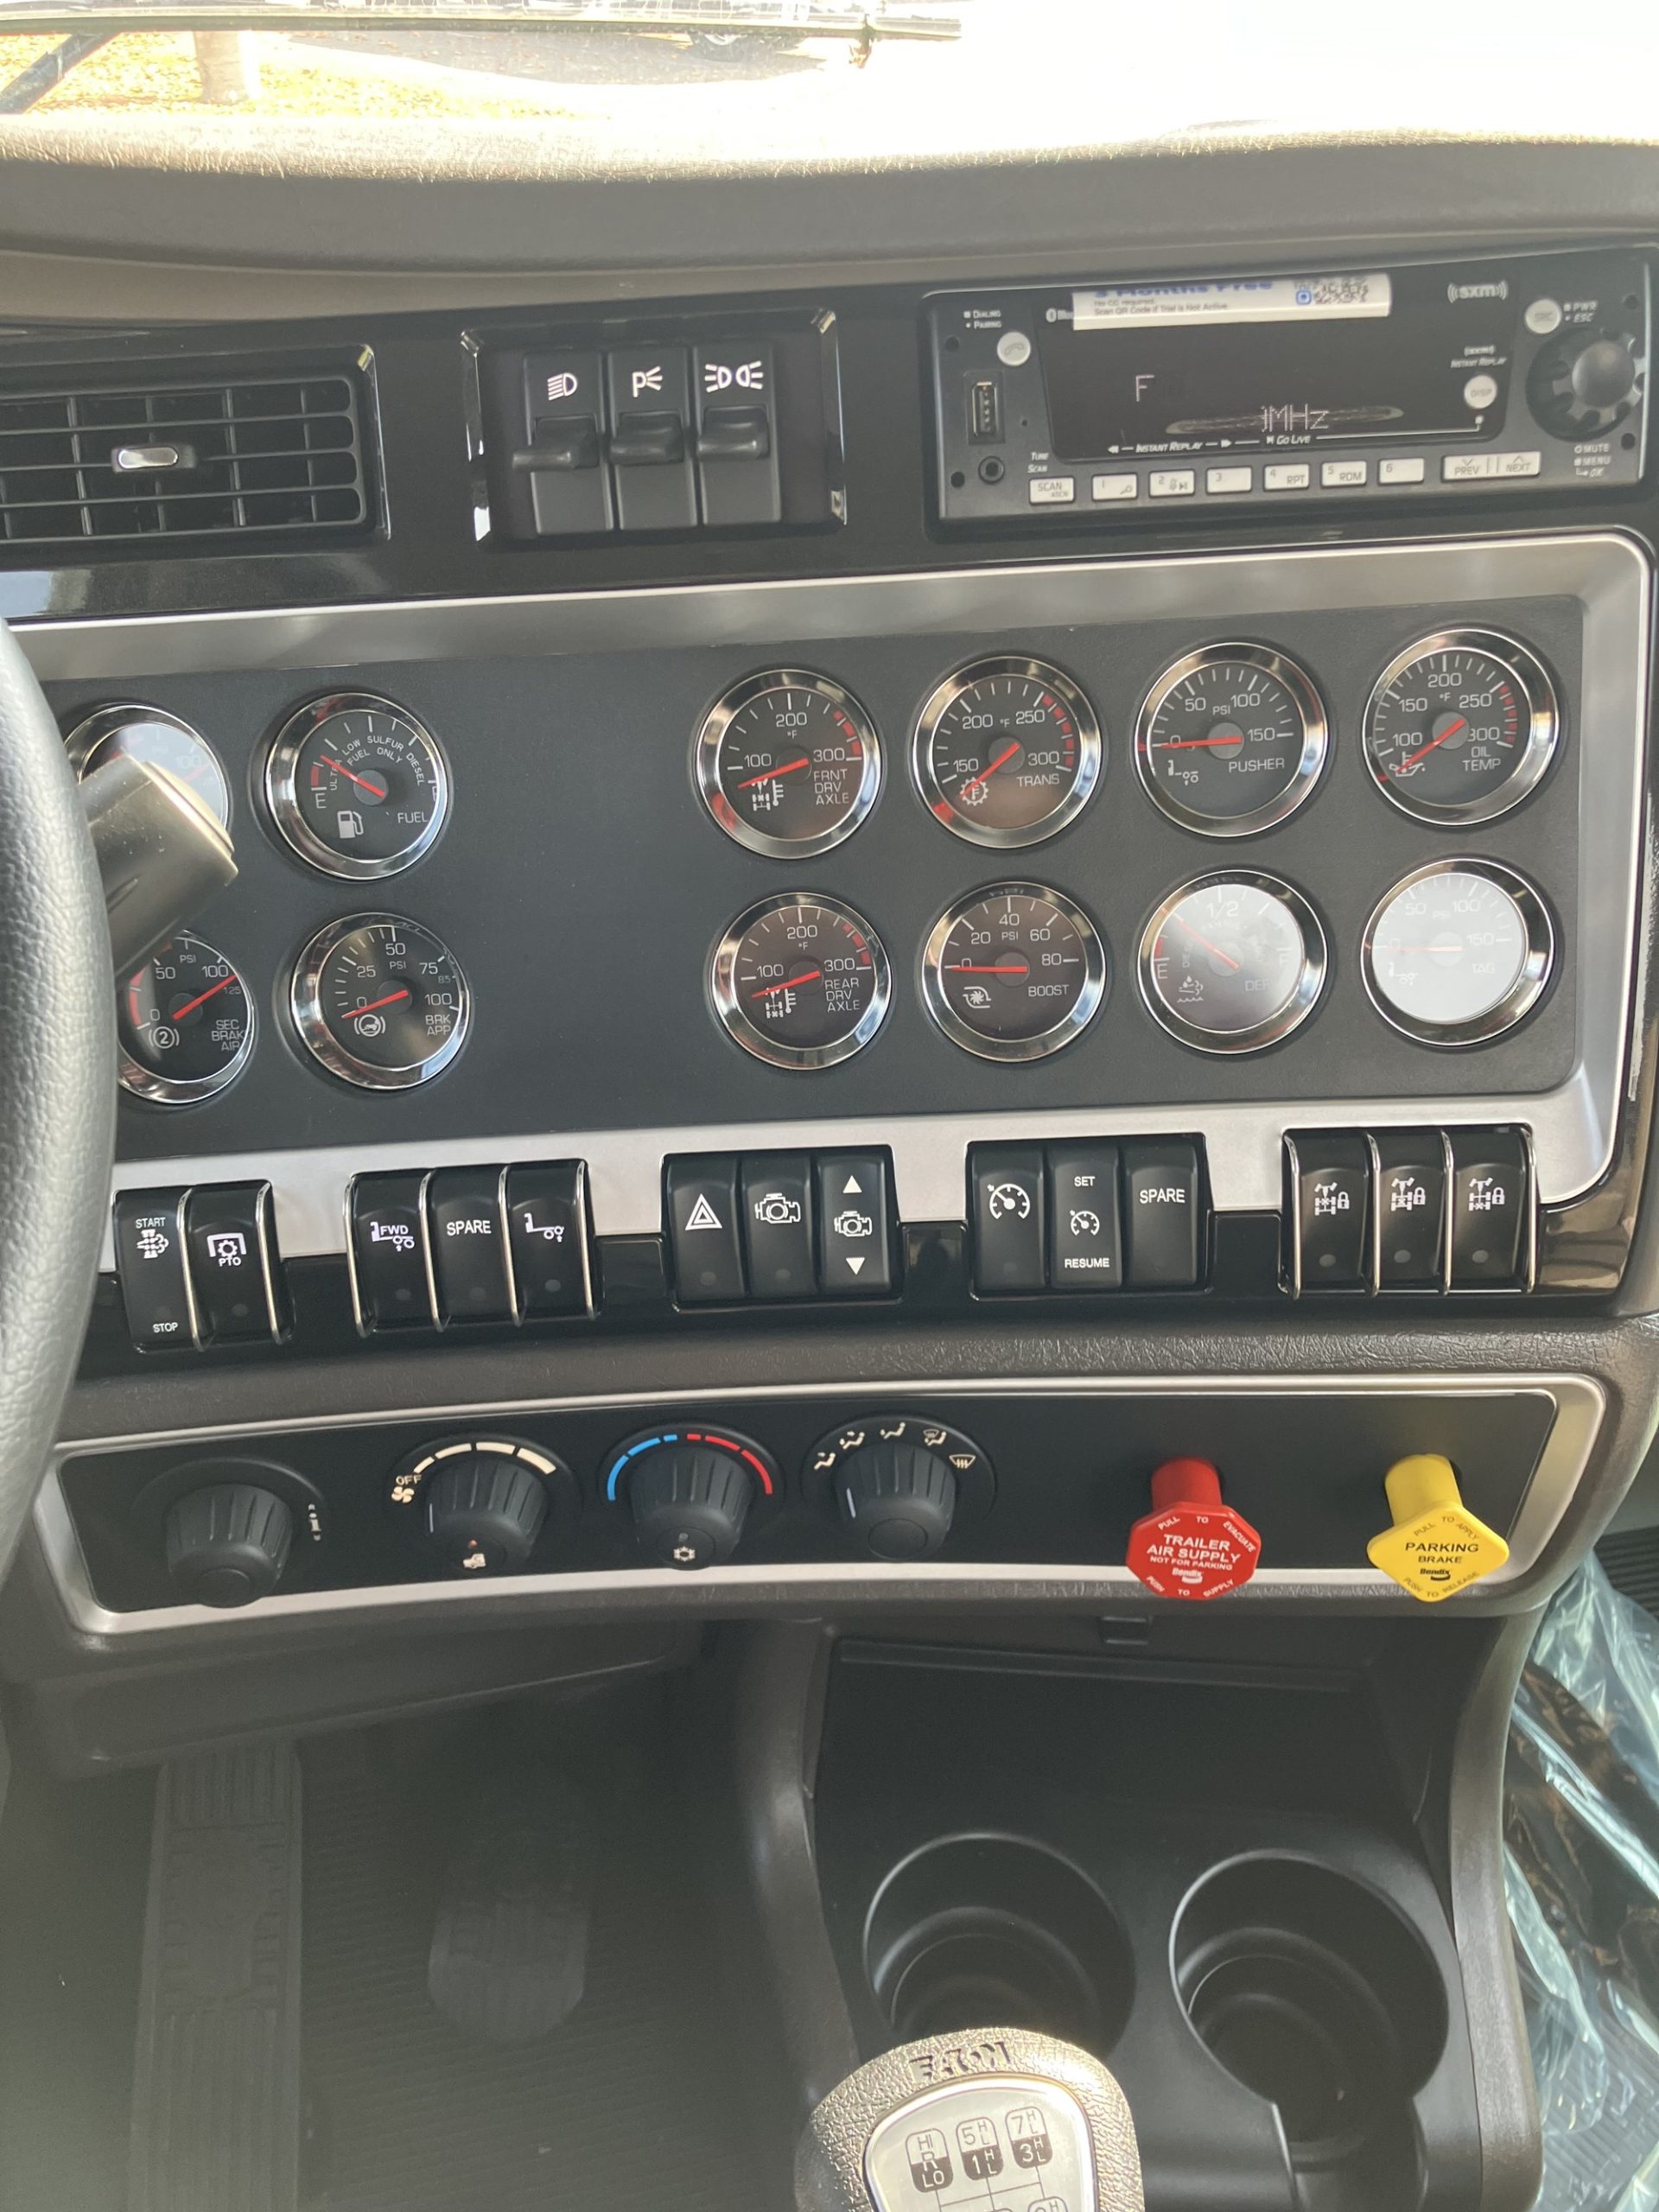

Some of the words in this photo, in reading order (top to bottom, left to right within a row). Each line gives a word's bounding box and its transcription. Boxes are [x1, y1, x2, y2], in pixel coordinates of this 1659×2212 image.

[1135, 374, 1155, 402] F
[1583, 443, 1610, 453] MUTE
[1506, 461, 1531, 473] NEXT
[1583, 455, 1611, 466] MENU
[1327, 465, 1335, 474] 5
[1386, 463, 1393, 474] 6
[1454, 465, 1480, 476] PREV
[1216, 473, 1223, 482] 3
[1287, 474, 1306, 485] RPT
[1339, 472, 1362, 482] RDM
[1038, 481, 1063, 492] SCAN
[1427, 672, 1462, 688] 200
[1185, 696, 1206, 712] 50
[1230, 693, 1261, 708] 100
[1398, 697, 1427, 713] 150
[1459, 693, 1492, 709] 250
[1212, 705, 1230, 715] PSI
[776, 712, 807, 728] 200
[962, 714, 994, 729] 200
[1015, 709, 1046, 725] 250
[1247, 727, 1275, 741] 150
[1393, 732, 1423, 747] 100
[1467, 727, 1500, 742] 300
[346, 748, 371, 766] FUEL
[377, 747, 403, 764] ONLY
[813, 747, 845, 763] 300
[1027, 751, 1059, 766] 300
[1471, 746, 1491, 758] OIL
[341, 739, 361, 755] LOW
[367, 735, 404, 752] SULFUR
[406, 753, 425, 786] DIESEL
[744, 753, 772, 767] 100
[953, 758, 979, 772] 150
[1229, 758, 1285, 773] PUSHER
[1462, 758, 1501, 772] TEMP
[813, 768, 848, 782] FRNT
[1016, 773, 1060, 787] TRANS
[815, 781, 842, 794] DRV
[315, 792, 327, 810] E
[816, 792, 849, 805] AXLE
[397, 811, 429, 823] FUEL
[1405, 901, 1426, 916] 50
[1452, 899, 1481, 912] 100
[999, 913, 1020, 926] 40
[786, 925, 817, 939] 200
[970, 931, 991, 944] 20
[1001, 931, 1019, 941] PSI
[1030, 928, 1051, 942] 60
[1466, 932, 1495, 946] 150
[385, 942, 406, 956] 50
[179, 954, 196, 963] PSI
[389, 961, 407, 969] PSI
[824, 957, 855, 972] 300
[1041, 953, 1062, 966] 80
[156, 966, 176, 980] 50
[201, 964, 229, 978] 100
[356, 965, 377, 978] 25
[418, 962, 439, 975] 75
[756, 963, 784, 978] 100
[1157, 963, 1168, 979] E
[437, 975, 451, 984] 85
[824, 977, 860, 990] REAR
[224, 985, 242, 995] 125
[826, 989, 852, 1002] DRV
[1028, 984, 1070, 997] BOOST
[356, 996, 367, 1008] 0
[424, 993, 453, 1006] 100
[827, 1000, 861, 1013] AXLE
[149, 1007, 161, 1021] 0
[425, 1014, 452, 1026] BRK
[215, 1019, 239, 1031] SEC
[427, 1025, 452, 1036] APP
[1074, 1176, 1096, 1186] SET
[1139, 1188, 1185, 1204] SPARE
[136, 1217, 166, 1229] START
[446, 1220, 492, 1236] SPARE
[380, 1225, 409, 1236] FWD
[218, 1257, 242, 1267] PTO
[1064, 1258, 1109, 1268] RESUME
[153, 1322, 178, 1333] STOP
[396, 1474, 422, 1485] OFF
[1158, 1516, 1180, 1530] PULL
[1223, 1521, 1256, 1553] EVACUATE
[1414, 1522, 1436, 1537] PULL
[1456, 1522, 1480, 1540] APPLY
[1164, 1534, 1230, 1551] TRAILER
[1405, 1541, 1479, 1553] PARKING
[1147, 1544, 1174, 1555] AIR
[1178, 1548, 1241, 1564] SUPPLY
[1418, 1555, 1462, 1564] BRAKE
[1150, 1555, 1169, 1564] NOT
[1172, 1558, 1190, 1567] FOR
[1192, 1560, 1233, 1571] PARKING
[1203, 1579, 1235, 1598] SUPPLY
[1442, 1571, 1480, 1593] RELEASE
